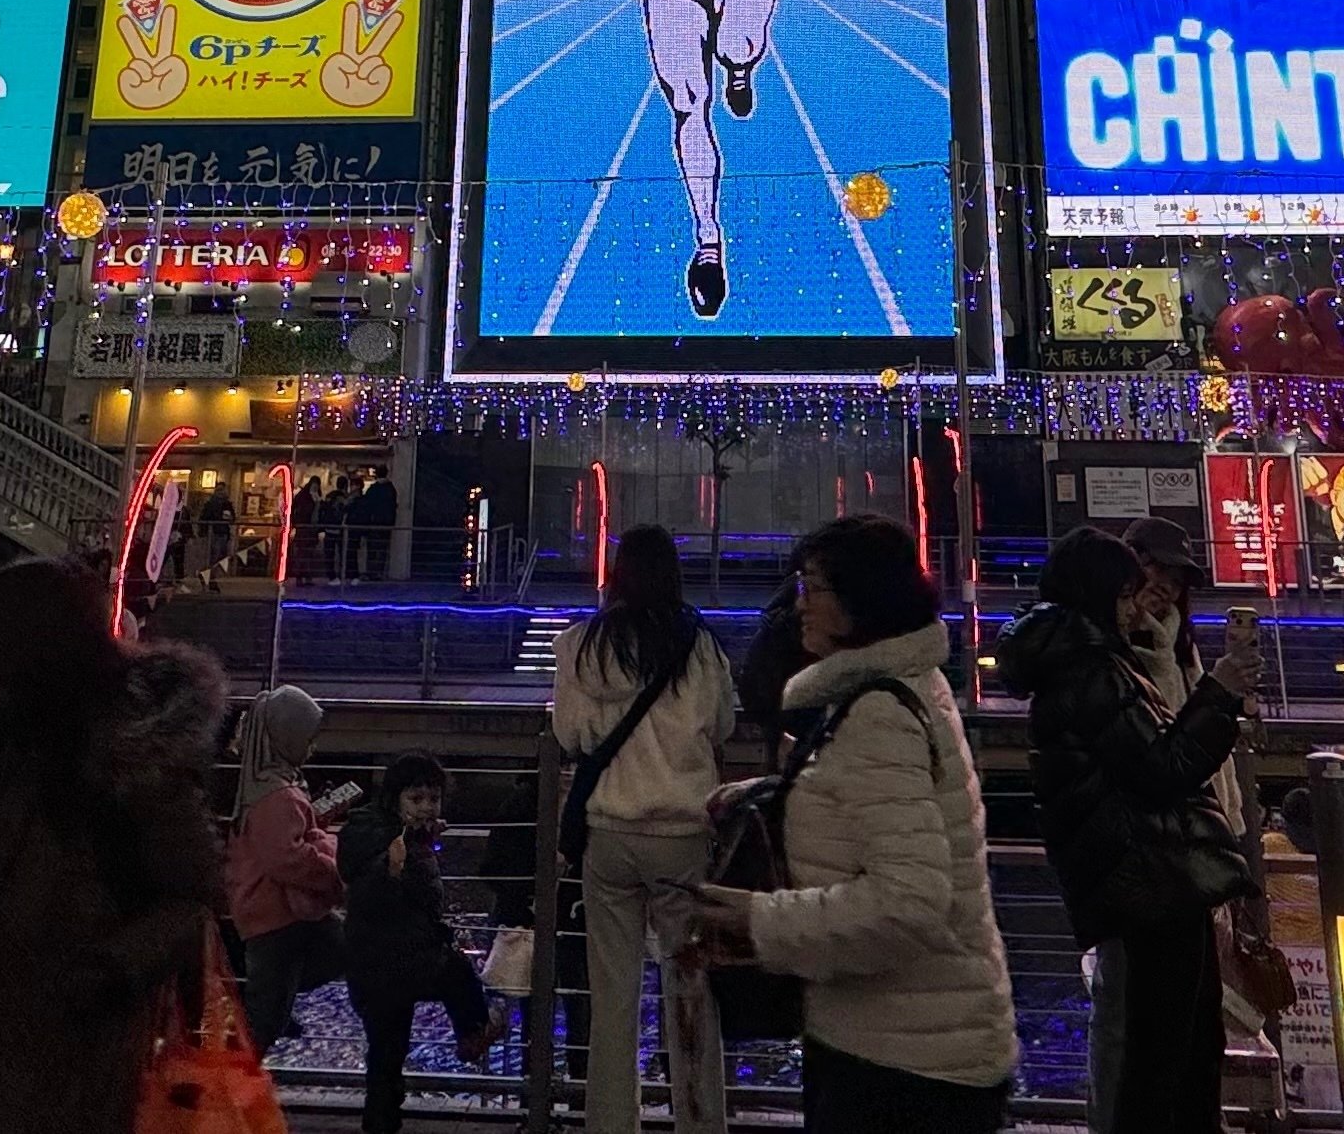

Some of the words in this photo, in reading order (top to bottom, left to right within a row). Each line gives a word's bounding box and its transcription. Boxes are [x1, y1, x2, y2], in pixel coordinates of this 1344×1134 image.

[1062, 206, 1126, 226] 天気予報
[104, 245, 270, 266] LOTTERIA
[1077, 277, 1156, 329] くくる
[1045, 346, 1152, 367] 大阪もんを食す
